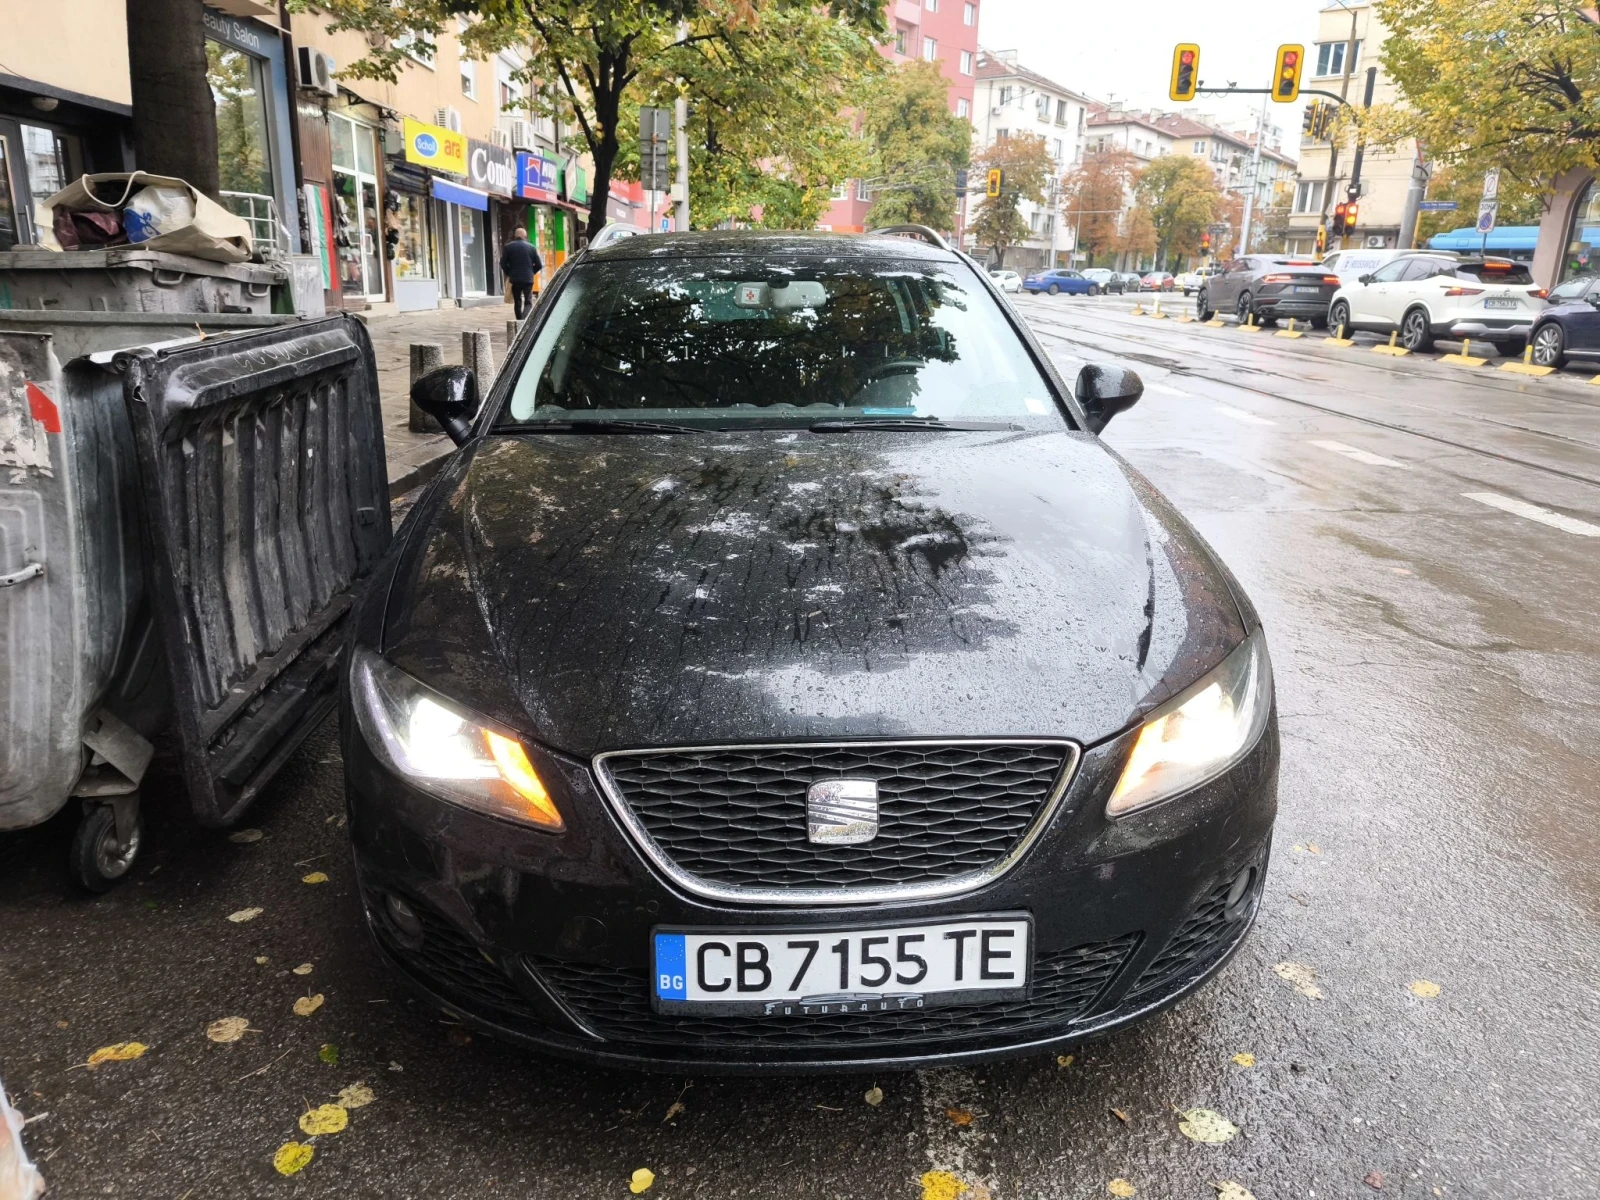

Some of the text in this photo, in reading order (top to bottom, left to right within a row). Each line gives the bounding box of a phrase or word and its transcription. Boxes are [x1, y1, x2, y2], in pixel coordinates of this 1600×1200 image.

[203, 13, 260, 49] eauty Salon
[697, 929, 1015, 993] CB 7155 TE
[660, 974, 684, 991] BG
[764, 998, 924, 1016] FUTURAUTO
